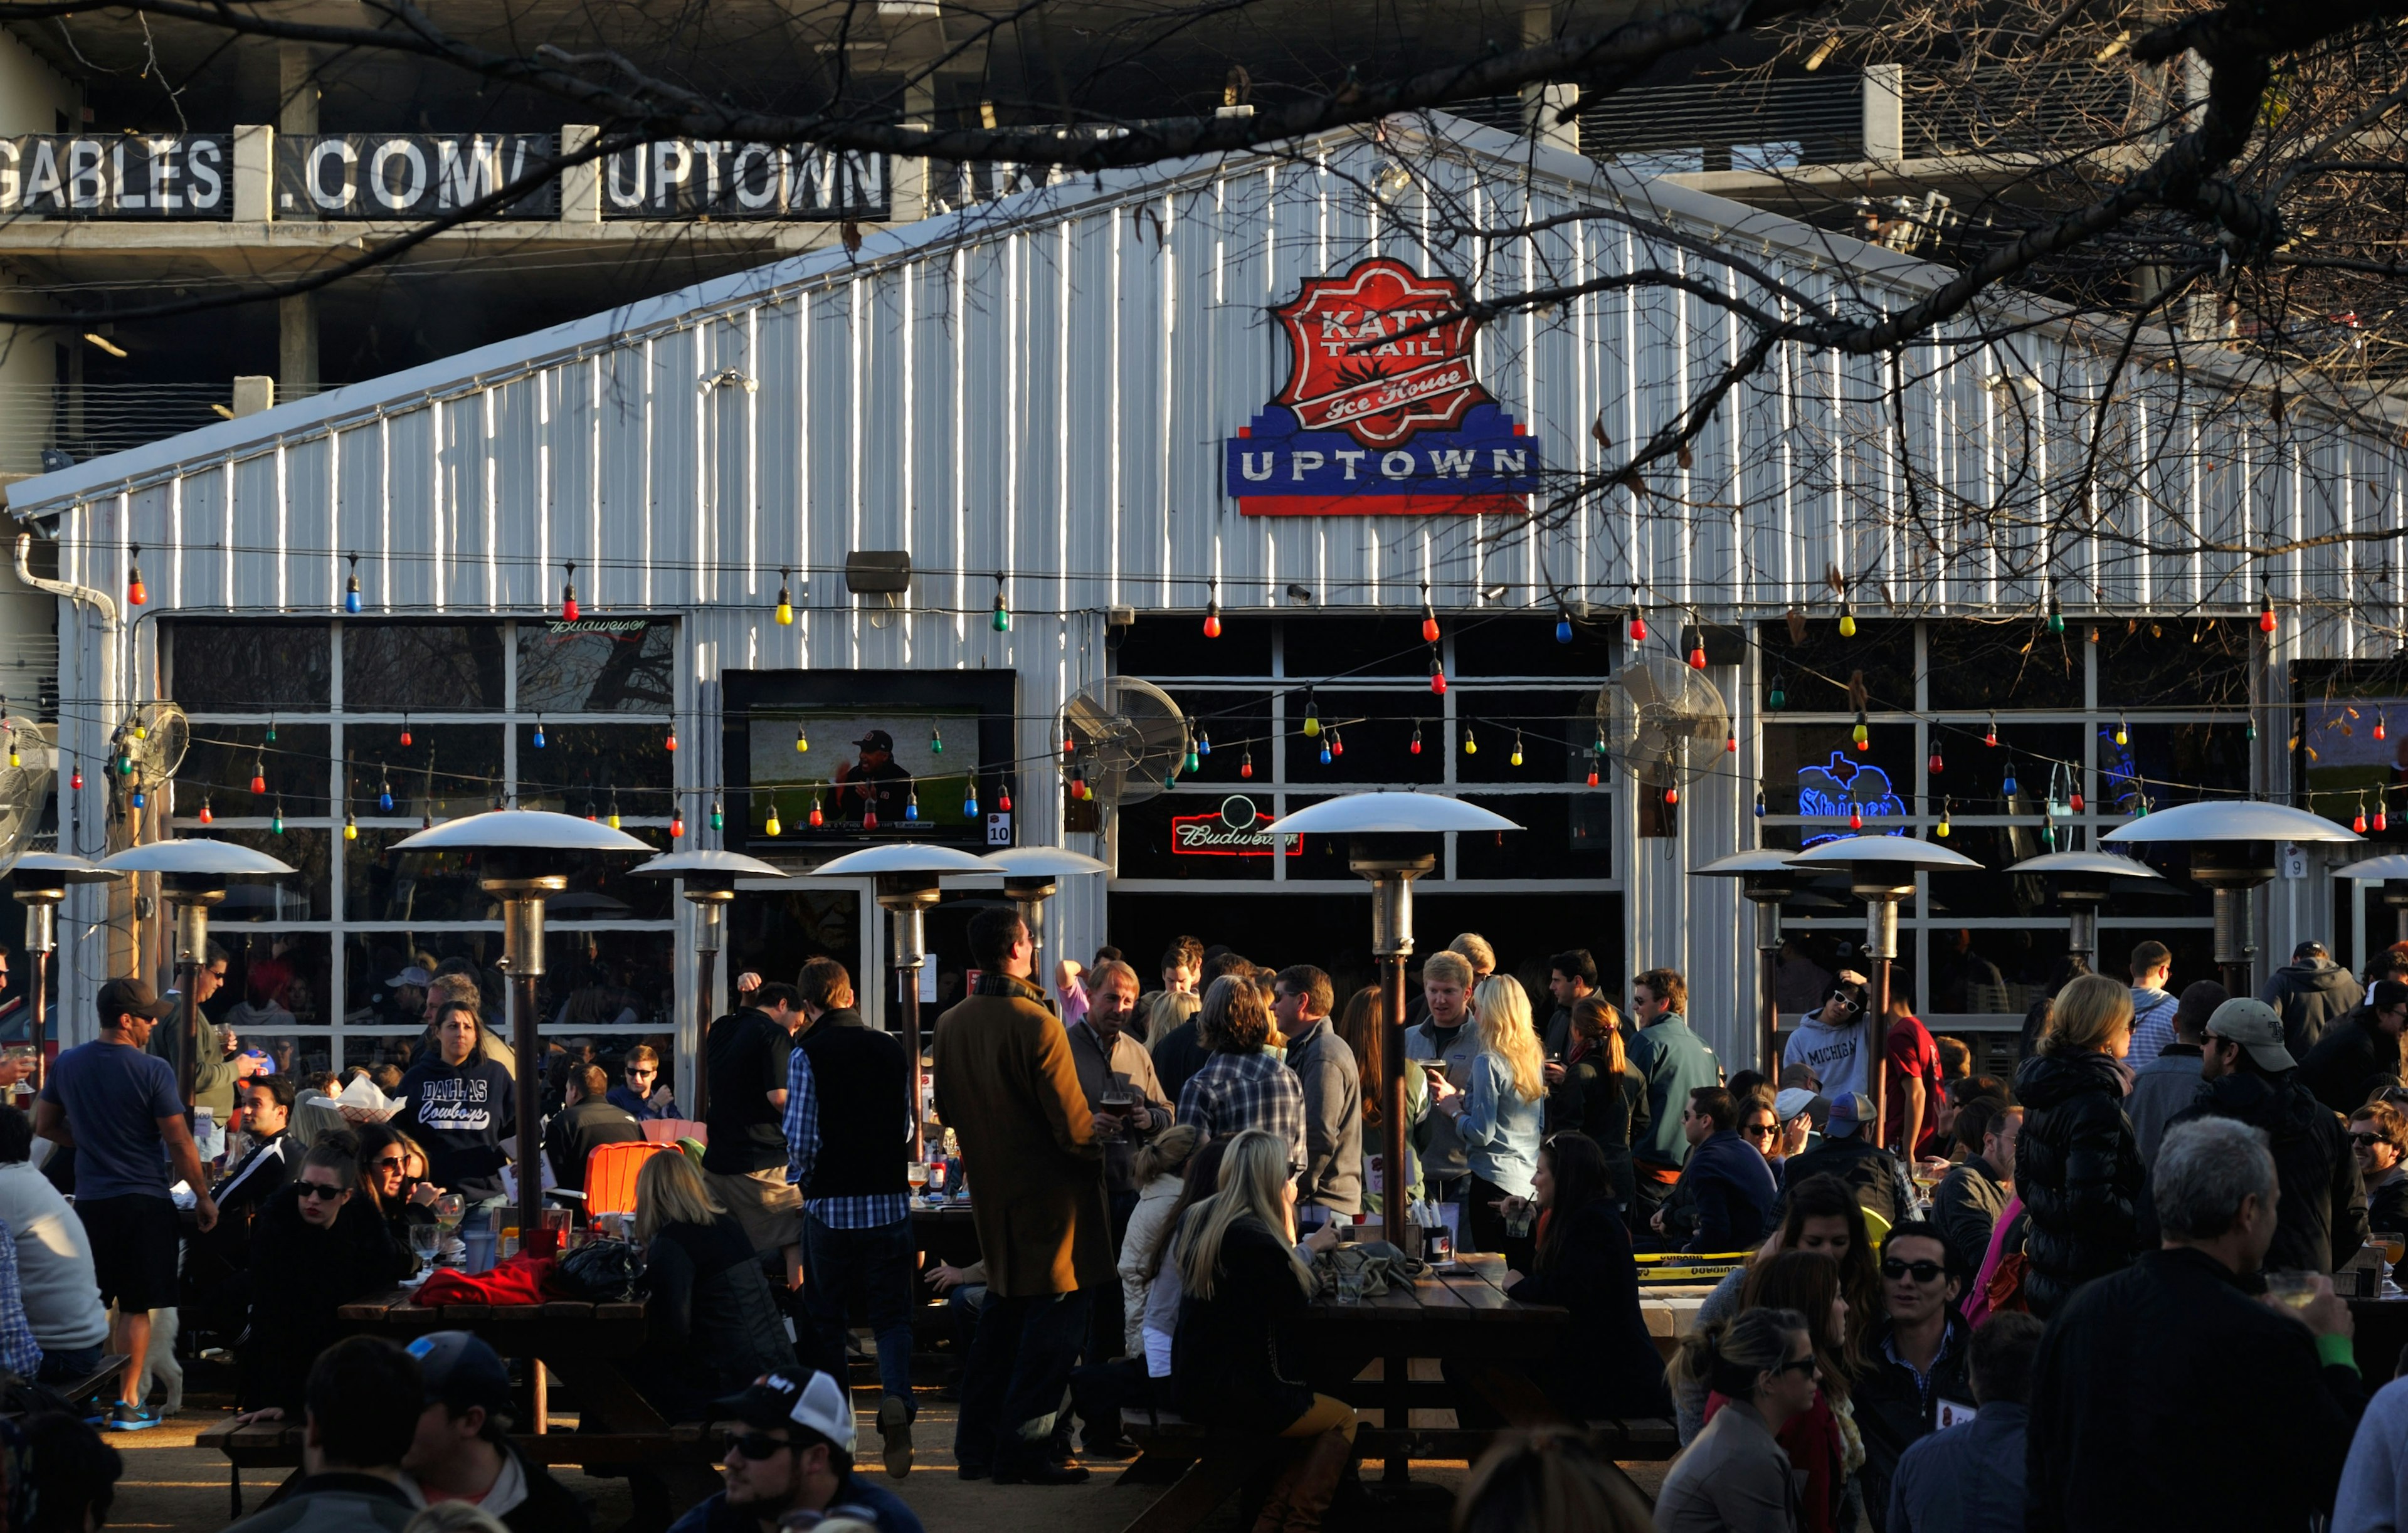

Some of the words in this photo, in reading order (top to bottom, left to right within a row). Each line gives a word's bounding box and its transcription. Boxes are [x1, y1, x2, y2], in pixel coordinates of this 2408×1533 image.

[0, 139, 222, 209] GABLES
[608, 139, 882, 209] UPTOWN
[1320, 310, 1448, 339] KATY
[1320, 341, 1444, 357] TRAIL
[1325, 396, 1371, 420] Ice
[1378, 369, 1461, 405] House
[1240, 449, 1528, 481] UPTOWN
[1799, 788, 1892, 816] Shiner
[990, 828, 1008, 841] 10
[1176, 824, 1299, 846] Budweisr
[2293, 861, 2301, 876] 9
[421, 1078, 488, 1102] DALLAS
[418, 1100, 490, 1130] Cowboys
